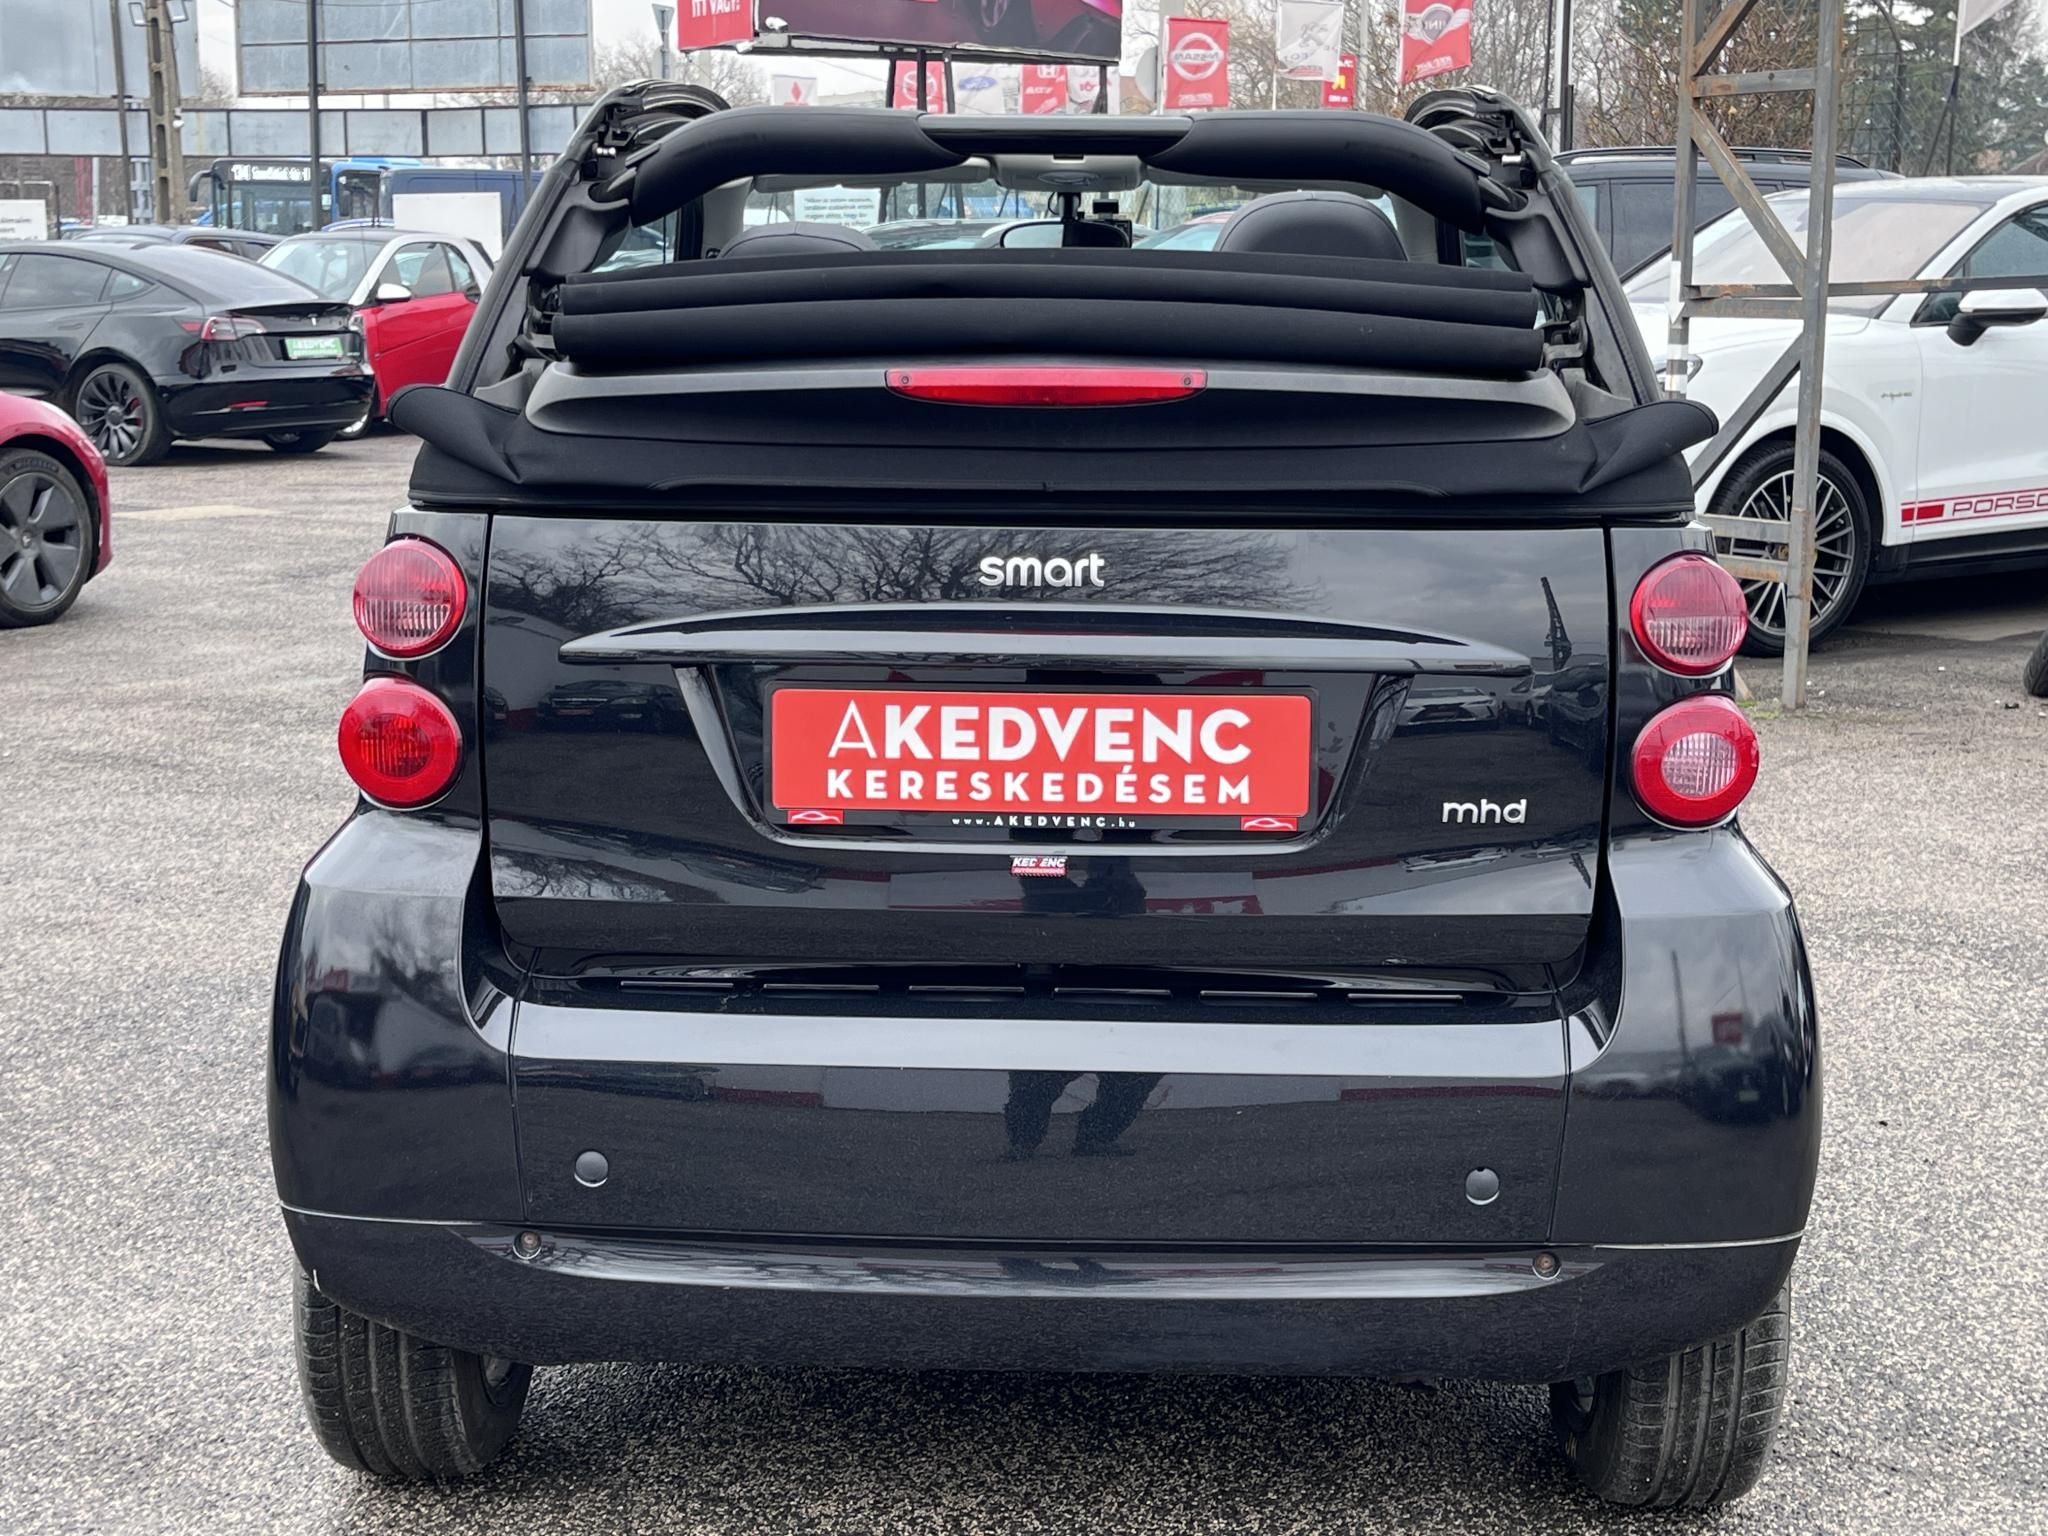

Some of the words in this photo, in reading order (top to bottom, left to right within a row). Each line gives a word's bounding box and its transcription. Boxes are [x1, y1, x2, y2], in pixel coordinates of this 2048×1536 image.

[978, 553, 1105, 587] smart
[827, 765, 1251, 804] KERESKEDÉSEM
[1442, 798, 1527, 824] mhd
